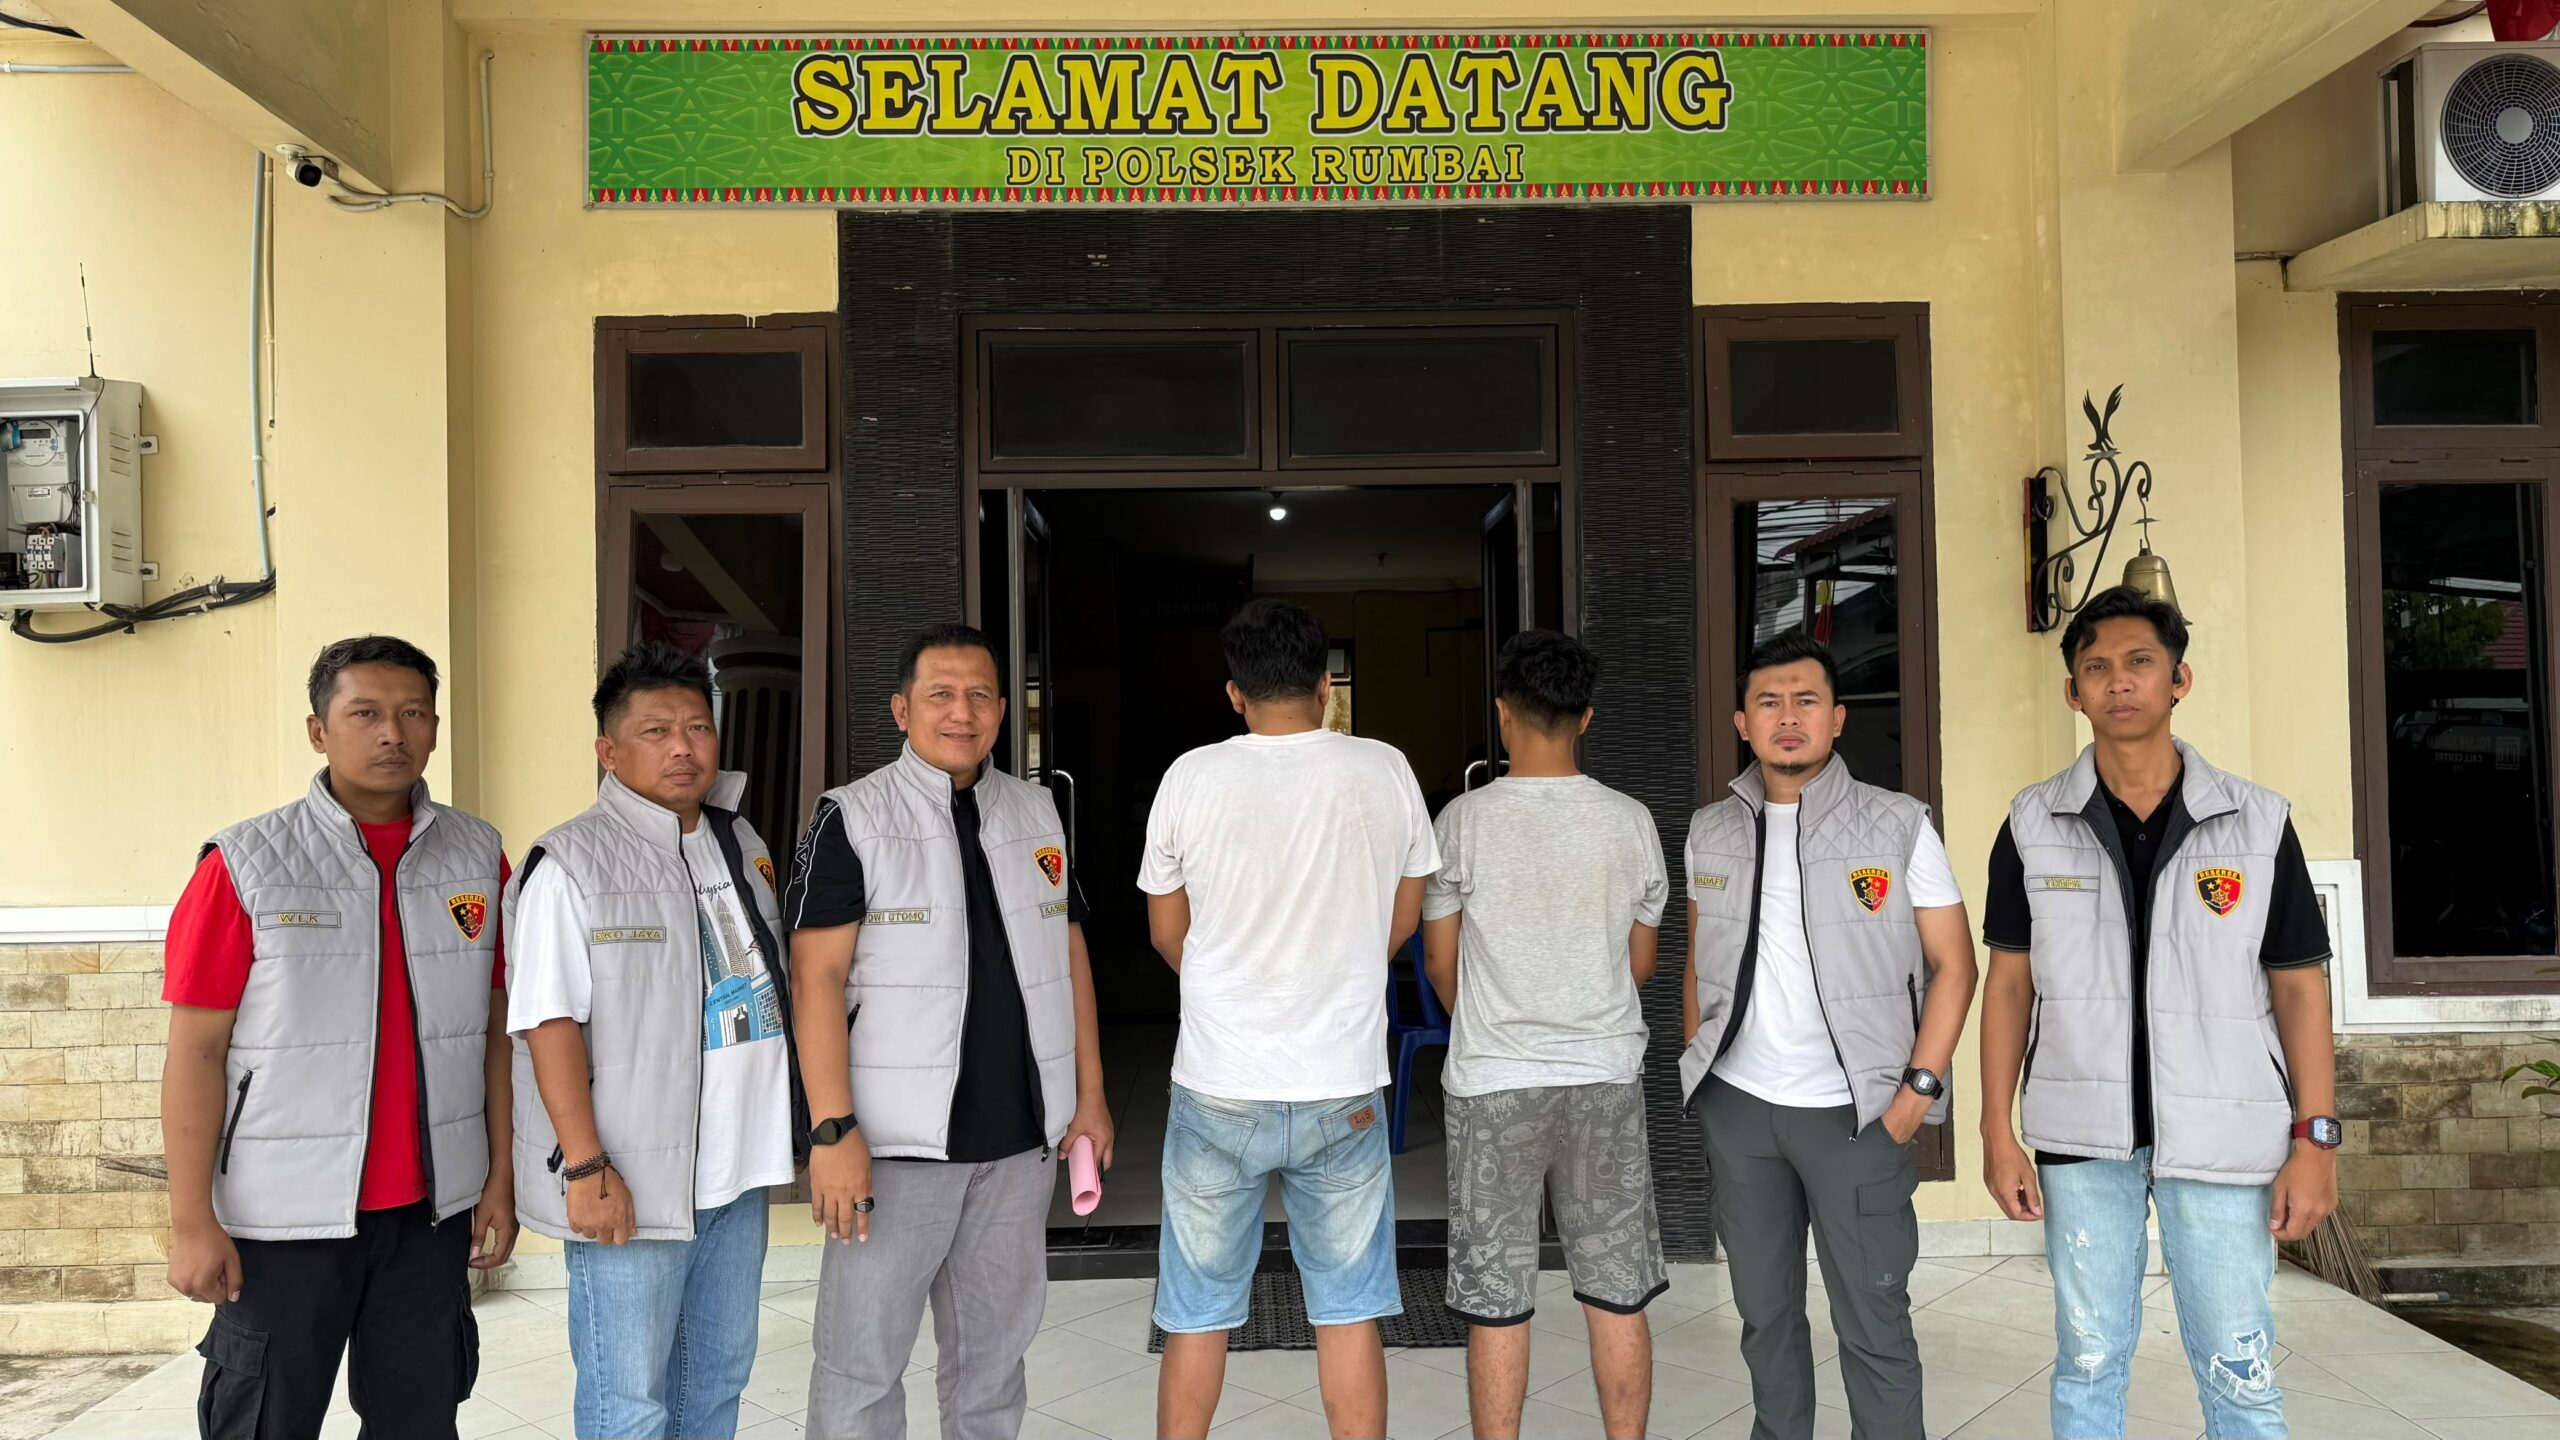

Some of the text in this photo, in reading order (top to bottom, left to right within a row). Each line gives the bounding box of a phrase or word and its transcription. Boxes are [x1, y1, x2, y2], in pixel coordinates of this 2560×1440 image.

[793, 50, 1732, 136] SELAMAT DATANG
[1006, 144, 1526, 186] DI POLSEK RUMBAI
[278, 912, 319, 926] WLK
[888, 911, 925, 922] UTOMO
